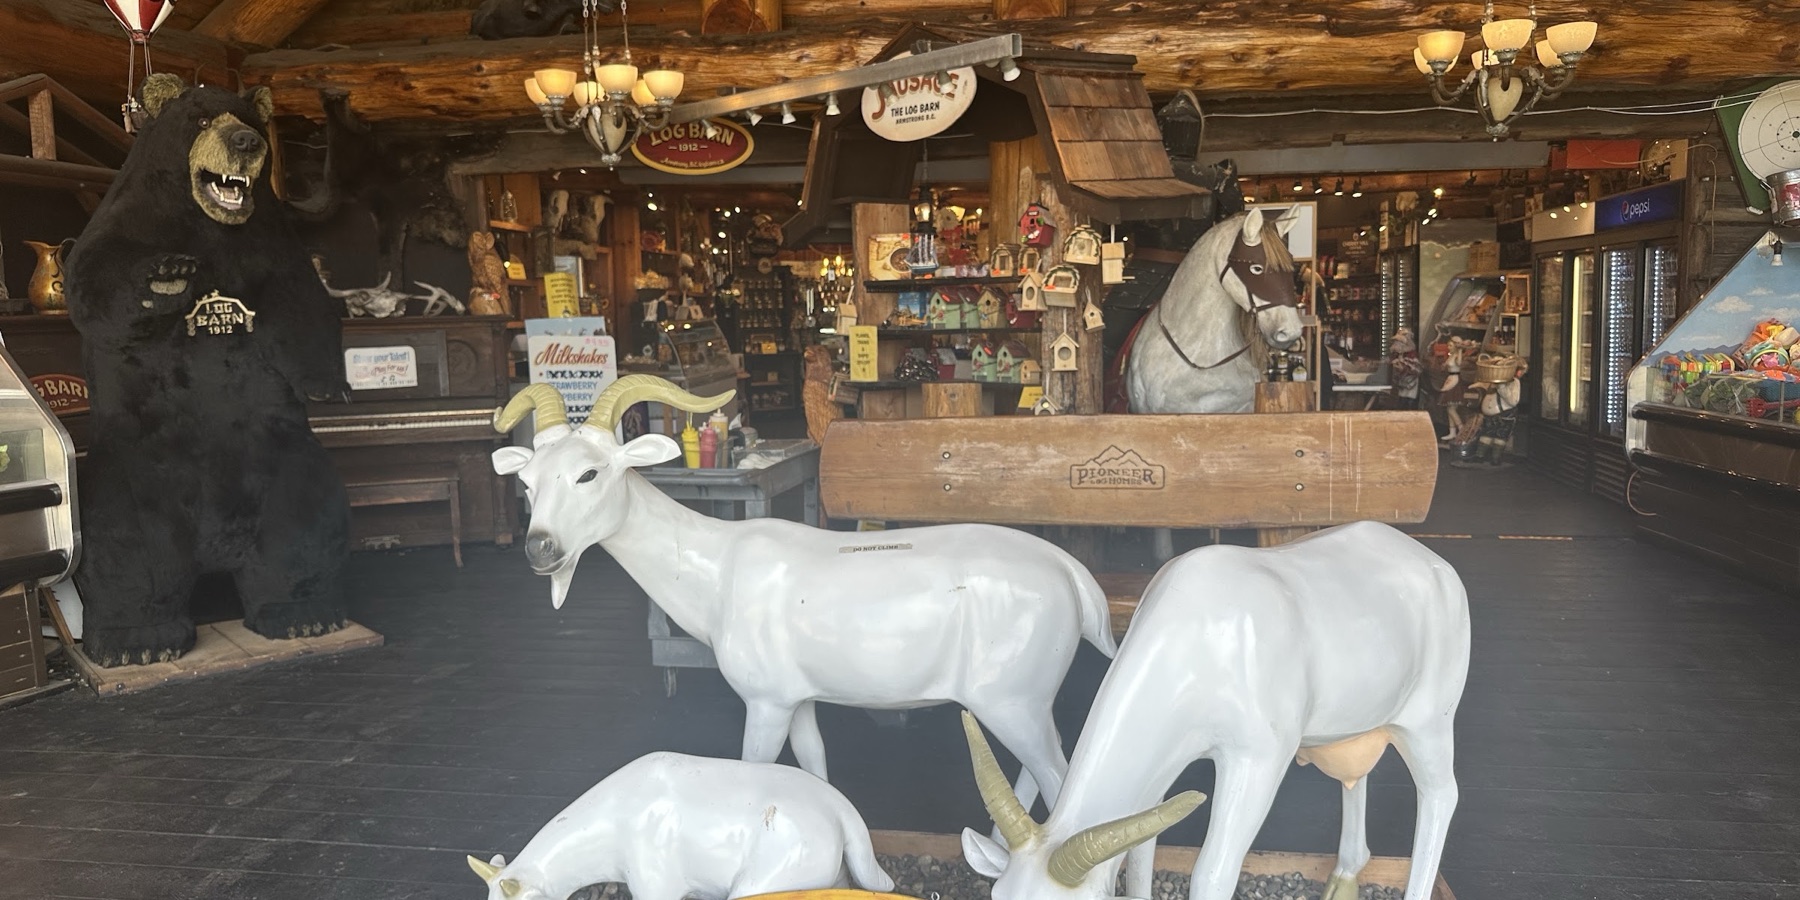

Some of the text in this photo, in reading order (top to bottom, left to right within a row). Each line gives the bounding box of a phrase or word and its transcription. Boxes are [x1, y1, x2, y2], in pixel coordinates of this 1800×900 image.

[891, 101, 941, 118] THE LOG BARN
[895, 116, 925, 125] ARMSTRONG
[649, 123, 686, 147] LOG
[678, 143, 699, 152] 1912
[1629, 197, 1651, 219] pepsi
[205, 302, 233, 315] LOG
[196, 312, 244, 327] BARN
[208, 325, 233, 335] 1912
[534, 342, 609, 366] Milkshakes
[550, 381, 598, 390] TRAWBERRY
[563, 392, 594, 401] PBERRY
[1076, 467, 1157, 486] PIONEER
[1108, 477, 1142, 486] HOMES
